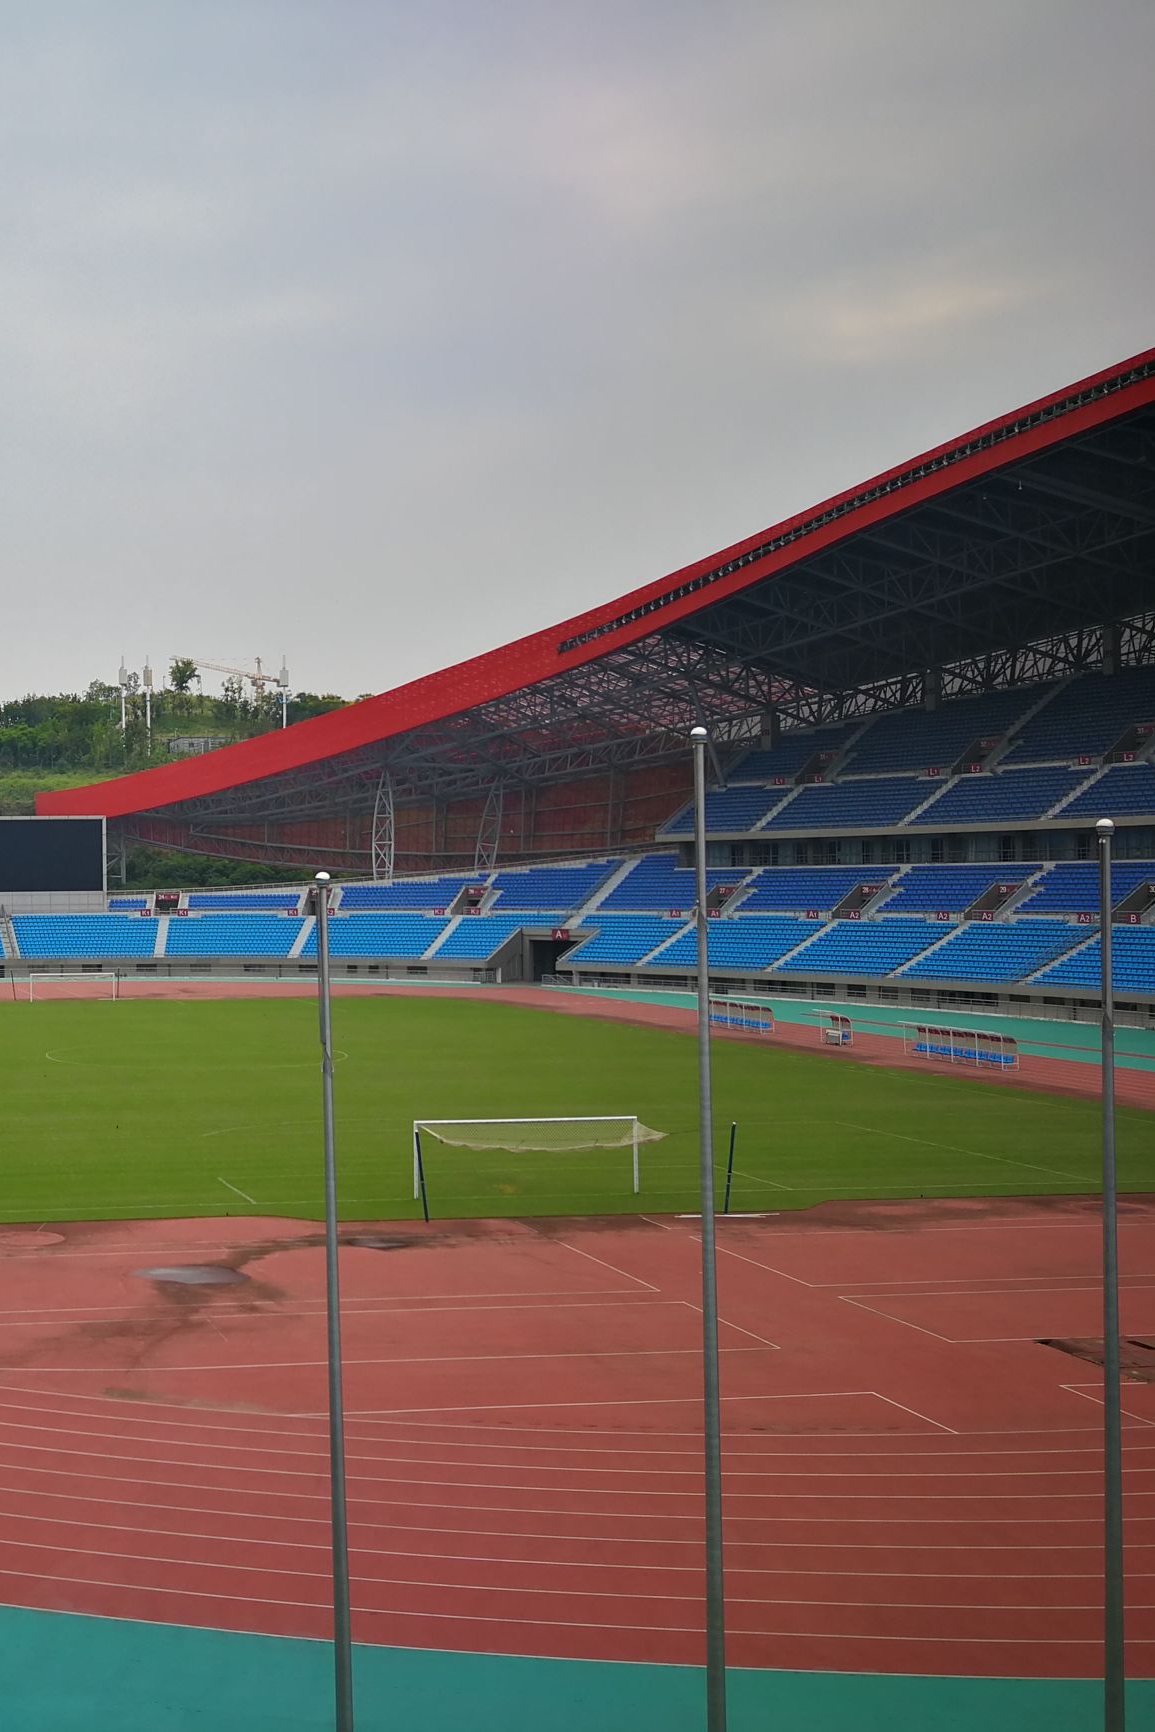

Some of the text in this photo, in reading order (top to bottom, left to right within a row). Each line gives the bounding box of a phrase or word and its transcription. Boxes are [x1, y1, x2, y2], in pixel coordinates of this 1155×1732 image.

[1079, 757, 1090, 765] L2
[971, 765, 980, 773] L2
[808, 910, 817, 919] A1
[849, 911, 859, 919] A2
[938, 912, 948, 920] A2
[982, 912, 992, 921] A2
[1079, 914, 1090, 923] A2
[1130, 914, 1137, 923] B
